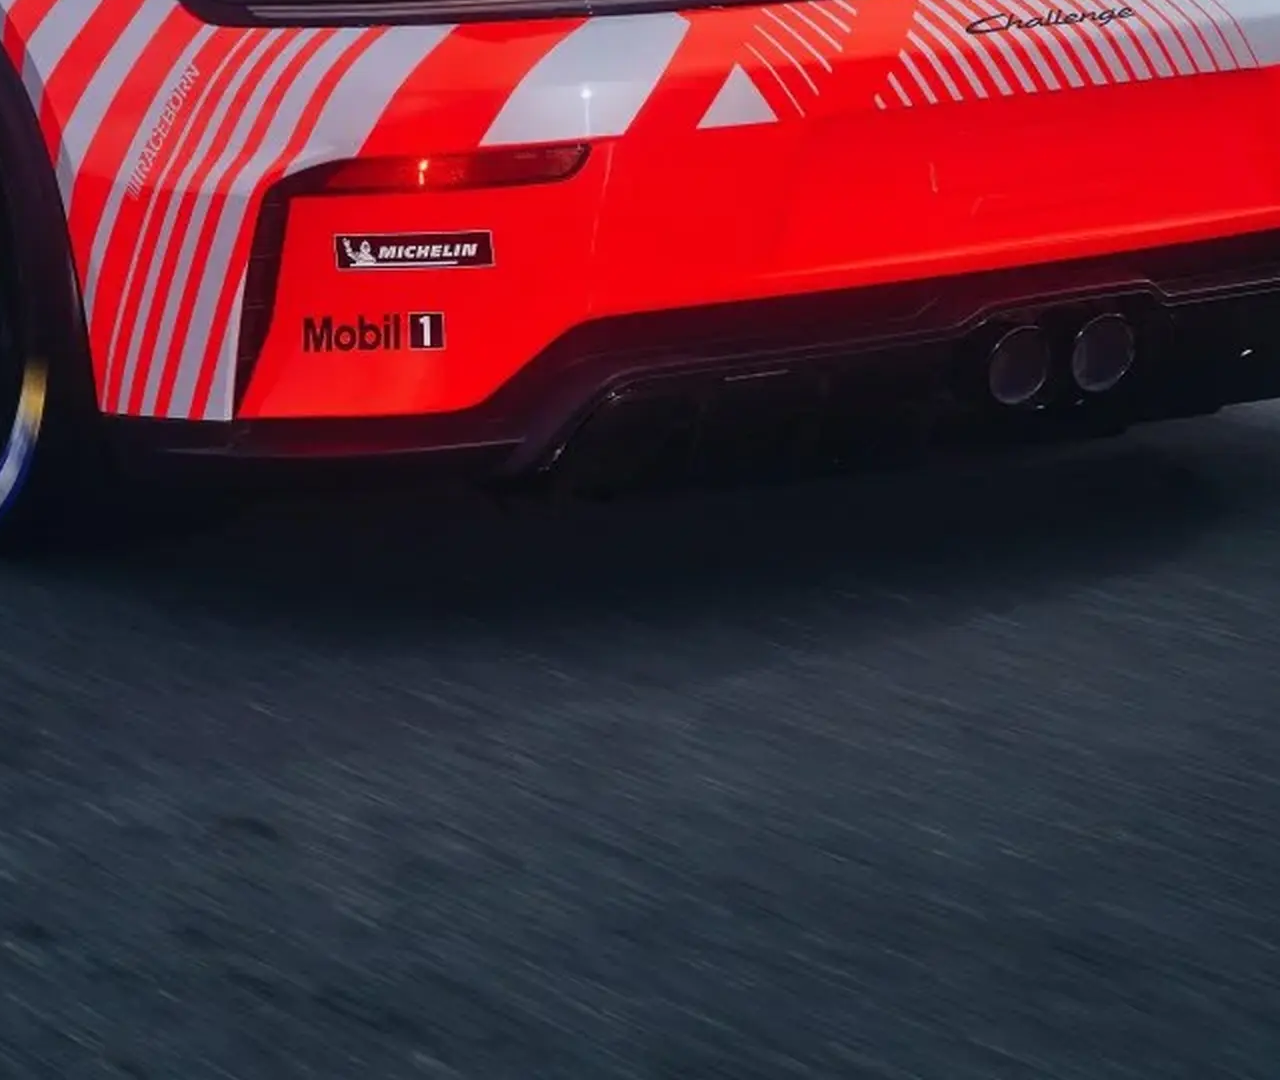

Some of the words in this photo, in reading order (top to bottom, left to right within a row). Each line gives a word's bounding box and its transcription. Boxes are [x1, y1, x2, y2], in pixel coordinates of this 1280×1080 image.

[966, 3, 1135, 36] Challenge
[377, 242, 478, 260] MICHELIN
[303, 315, 401, 353] Mobil
